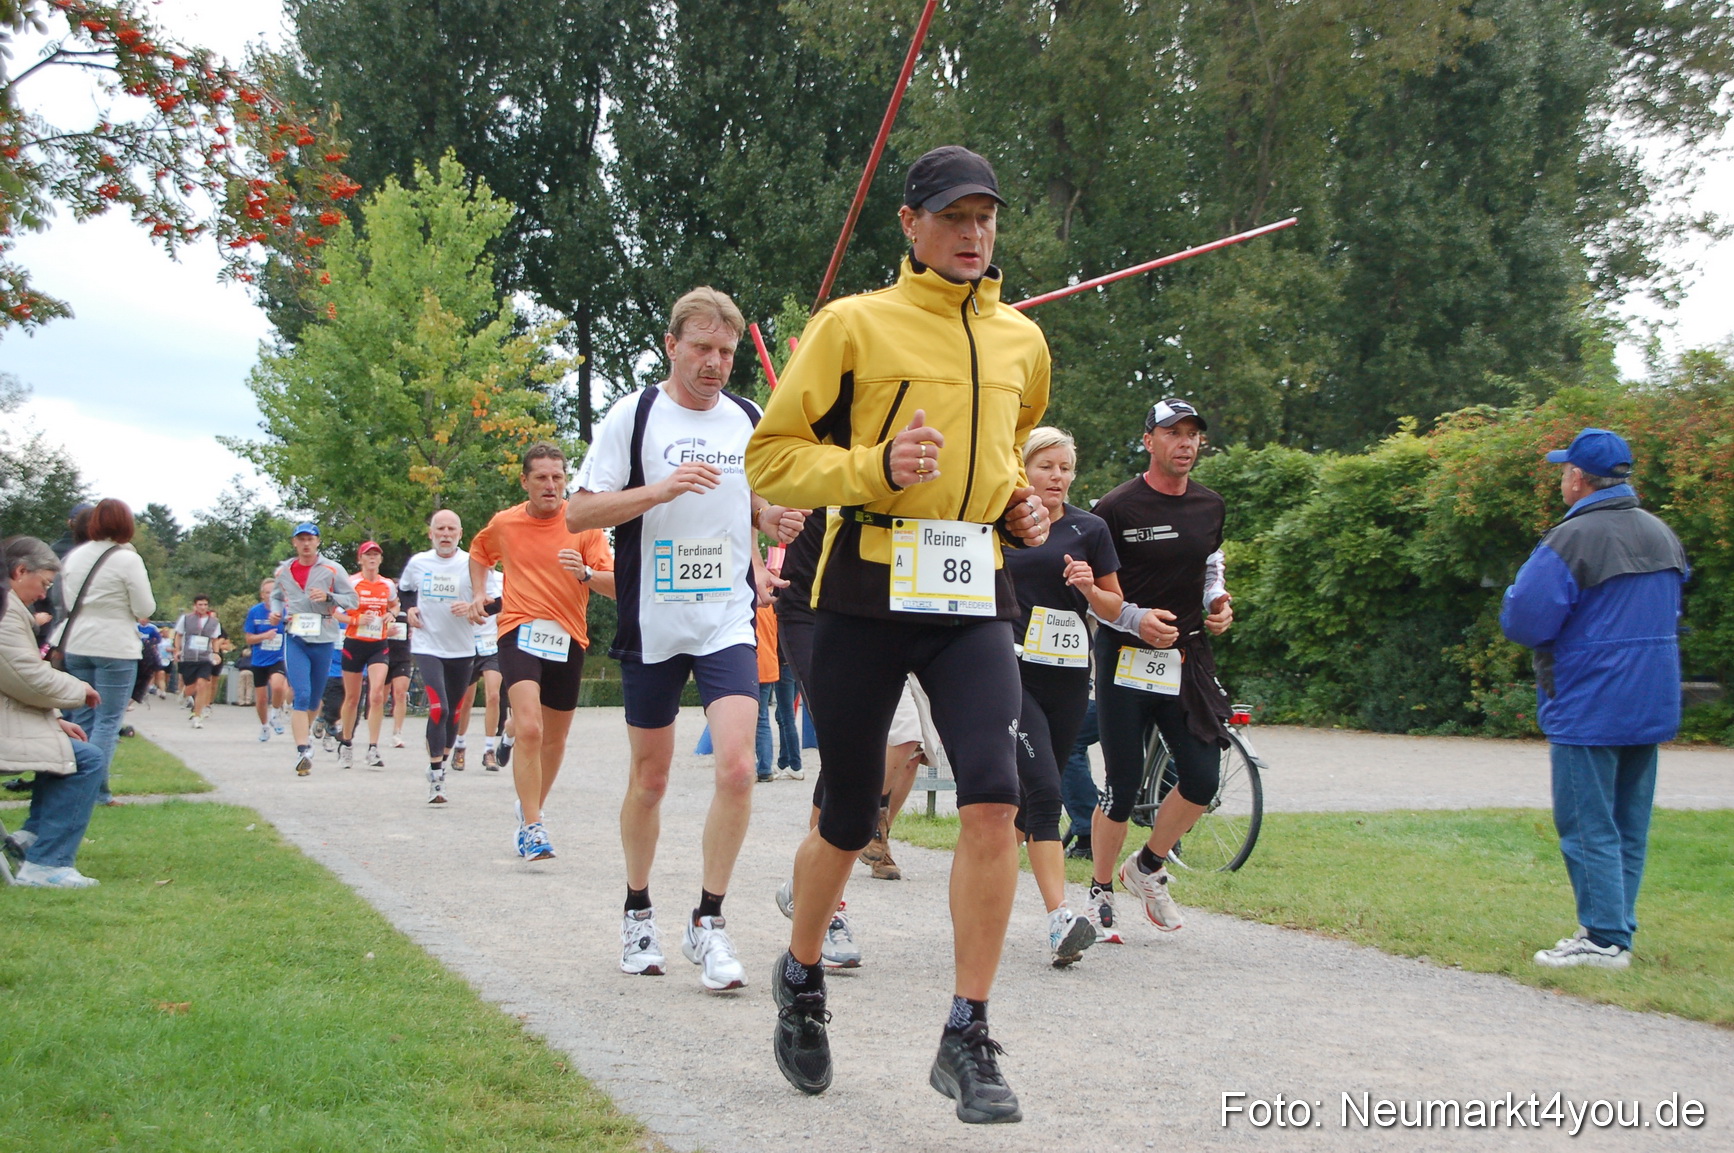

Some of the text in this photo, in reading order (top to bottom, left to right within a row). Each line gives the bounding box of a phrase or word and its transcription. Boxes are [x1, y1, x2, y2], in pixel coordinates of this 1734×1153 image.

[680, 450, 744, 465] Fischer
[924, 528, 967, 547] Reiner
[678, 544, 723, 556] Ferdinand
[660, 562, 666, 572] C
[896, 554, 903, 567] A
[679, 562, 722, 580] 2821
[943, 558, 972, 584] 88
[433, 583, 456, 593] 2049
[1046, 613, 1076, 628] Claudia
[533, 632, 564, 647] 3714
[1051, 632, 1080, 649] 153
[1145, 661, 1166, 676] 58
